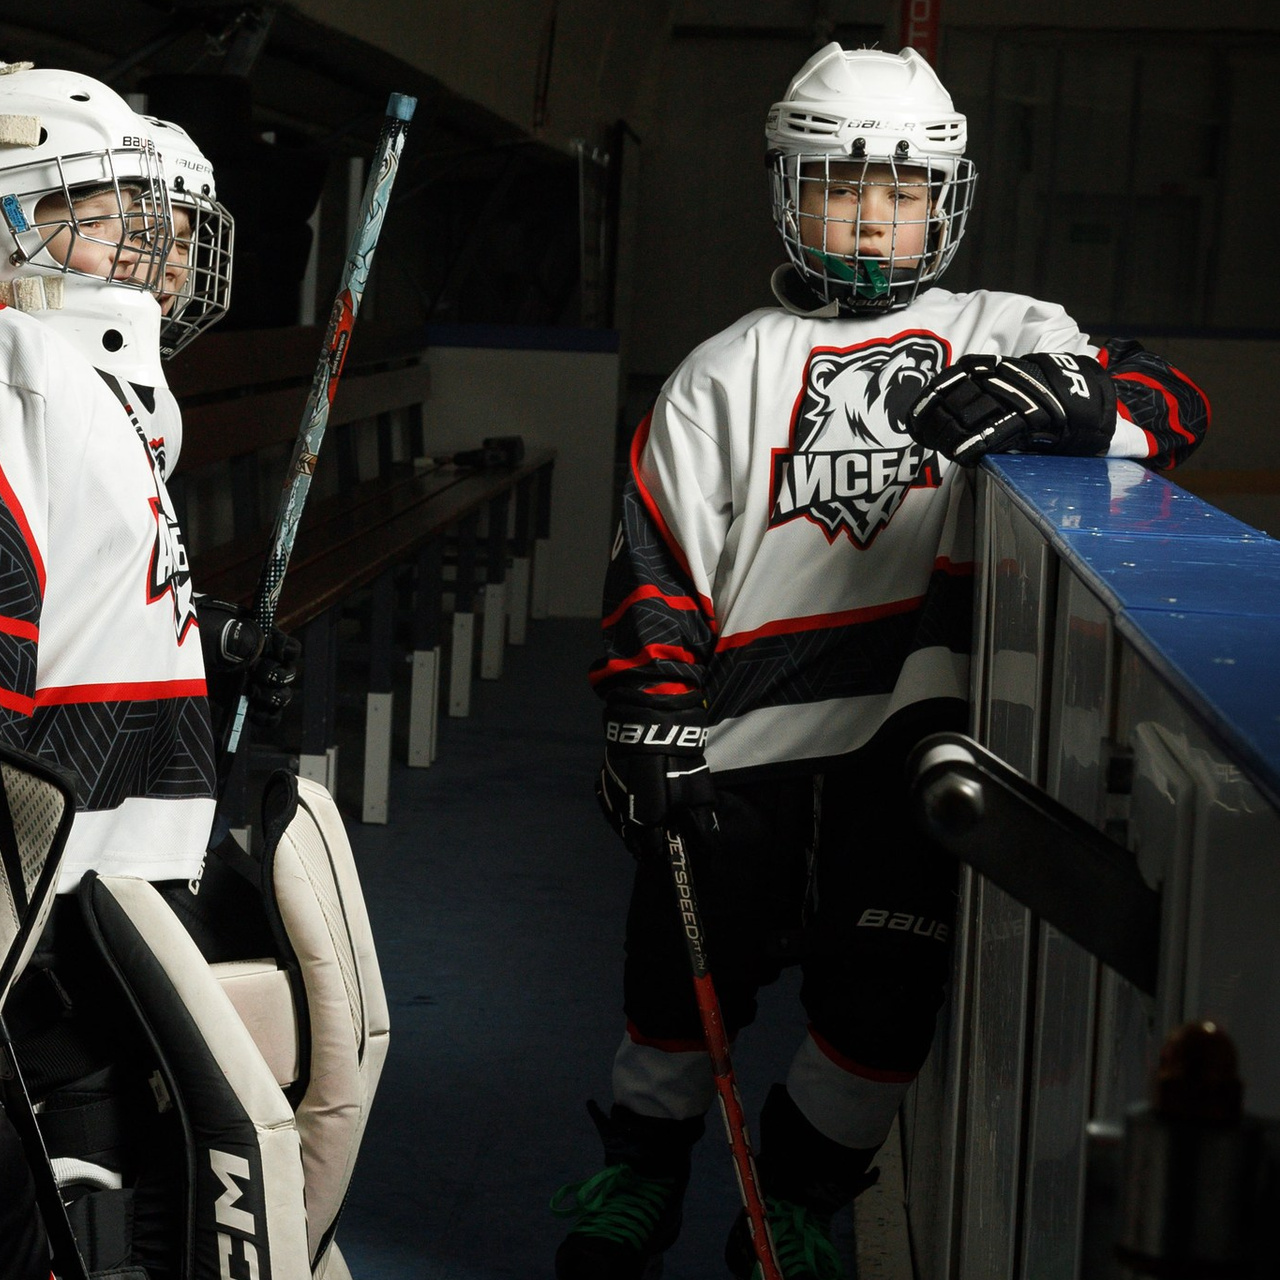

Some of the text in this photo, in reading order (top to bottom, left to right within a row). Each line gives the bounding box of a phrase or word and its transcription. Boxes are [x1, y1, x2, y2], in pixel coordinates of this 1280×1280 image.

[606, 721, 708, 748] BAUER
[667, 830, 703, 940] JETSPEED
[856, 908, 952, 944] BAUE
